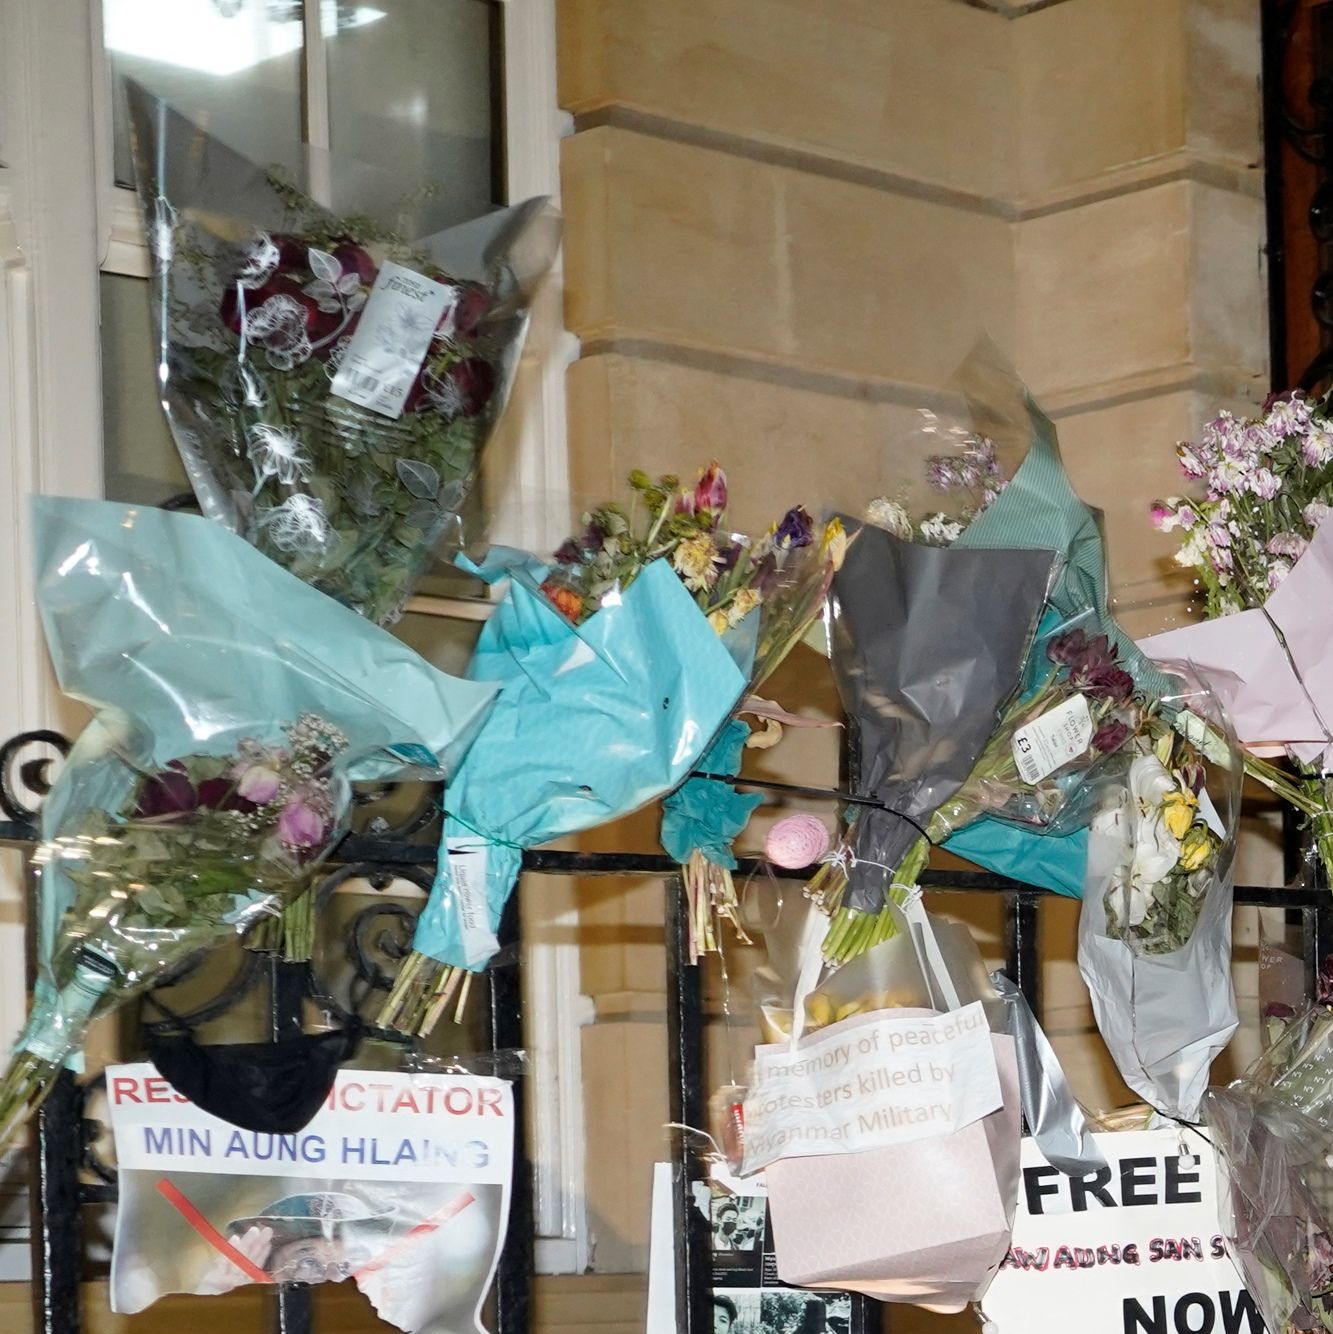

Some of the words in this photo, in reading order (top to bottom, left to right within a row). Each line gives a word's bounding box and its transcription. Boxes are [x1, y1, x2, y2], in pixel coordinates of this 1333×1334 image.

[1066, 710, 1083, 744] FLOWER
[1017, 737, 1032, 753] £3
[767, 1047, 850, 1081] memory
[857, 1028, 881, 1054] of
[889, 1007, 986, 1053] peaceful
[858, 1062, 923, 1096] killed
[930, 1061, 955, 1084] by
[327, 1082, 504, 1117] ICTATOR
[857, 1103, 952, 1135] Military
[143, 1126, 212, 1158] MIN
[225, 1130, 327, 1164] AUNG
[342, 1137, 490, 1169] HLAING
[1022, 1154, 1203, 1216] FREE
[1148, 1236, 1205, 1263] SAN
